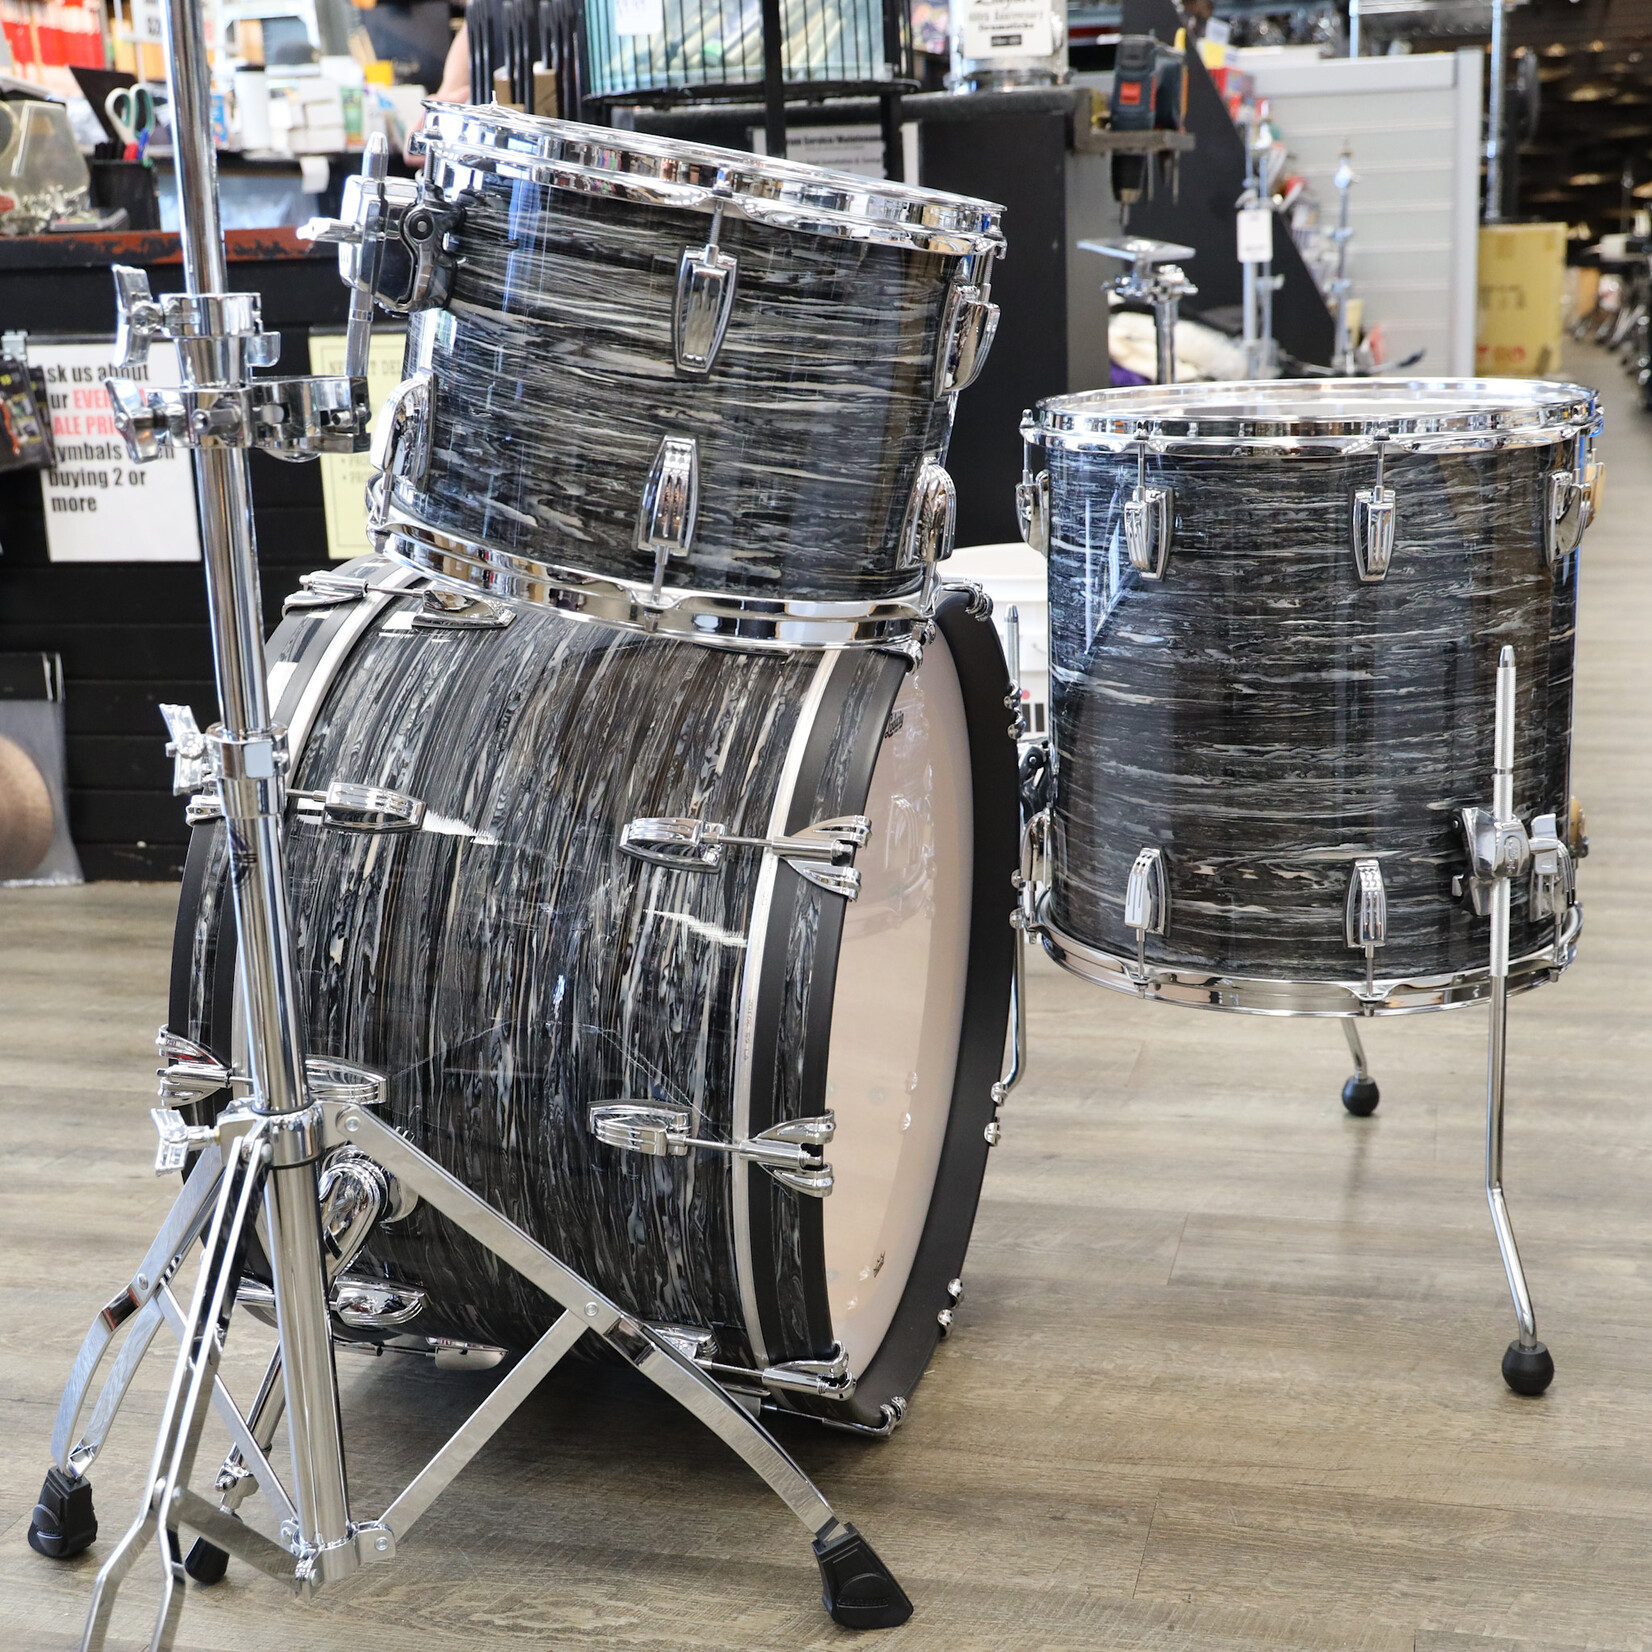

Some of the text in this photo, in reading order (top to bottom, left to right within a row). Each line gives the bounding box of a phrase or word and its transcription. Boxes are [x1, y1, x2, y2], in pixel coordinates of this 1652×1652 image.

[47, 363, 150, 383] sk us about
[51, 393, 68, 409] ur
[53, 415, 117, 436] ALE PRI
[56, 442, 122, 462] ymbals
[50, 467, 146, 488] buying 2 or
[52, 496, 97, 512] more
